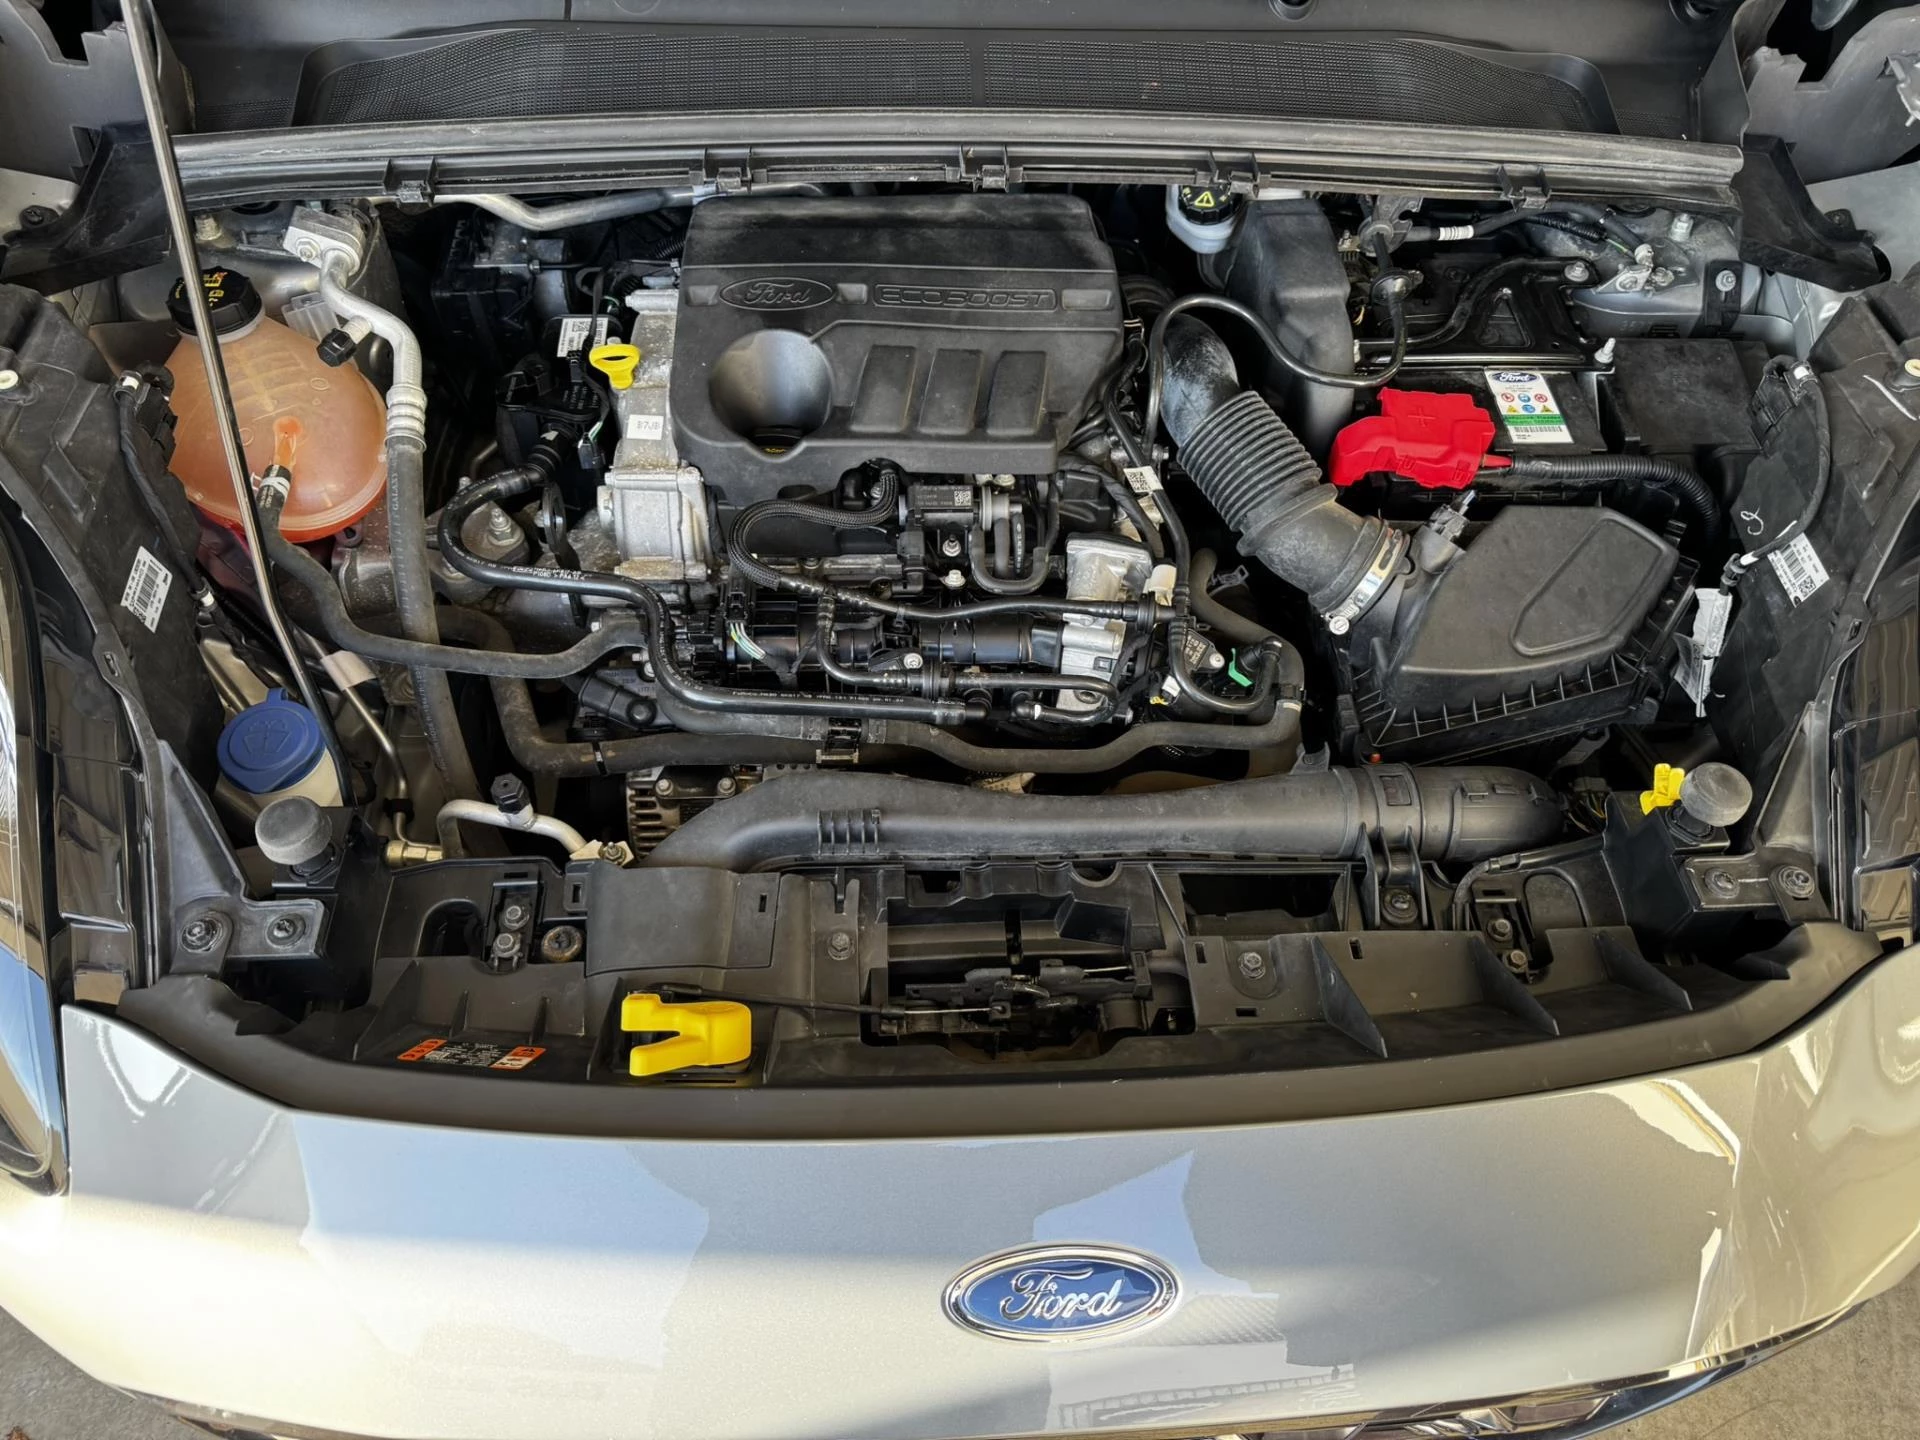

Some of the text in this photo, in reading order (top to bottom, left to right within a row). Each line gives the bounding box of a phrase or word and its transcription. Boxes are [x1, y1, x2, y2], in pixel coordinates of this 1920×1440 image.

[744, 282, 811, 304] Ford
[881, 288, 1050, 308] ECOBOOST
[1499, 372, 1530, 381] Ford
[1000, 1267, 1123, 1321] Ford
